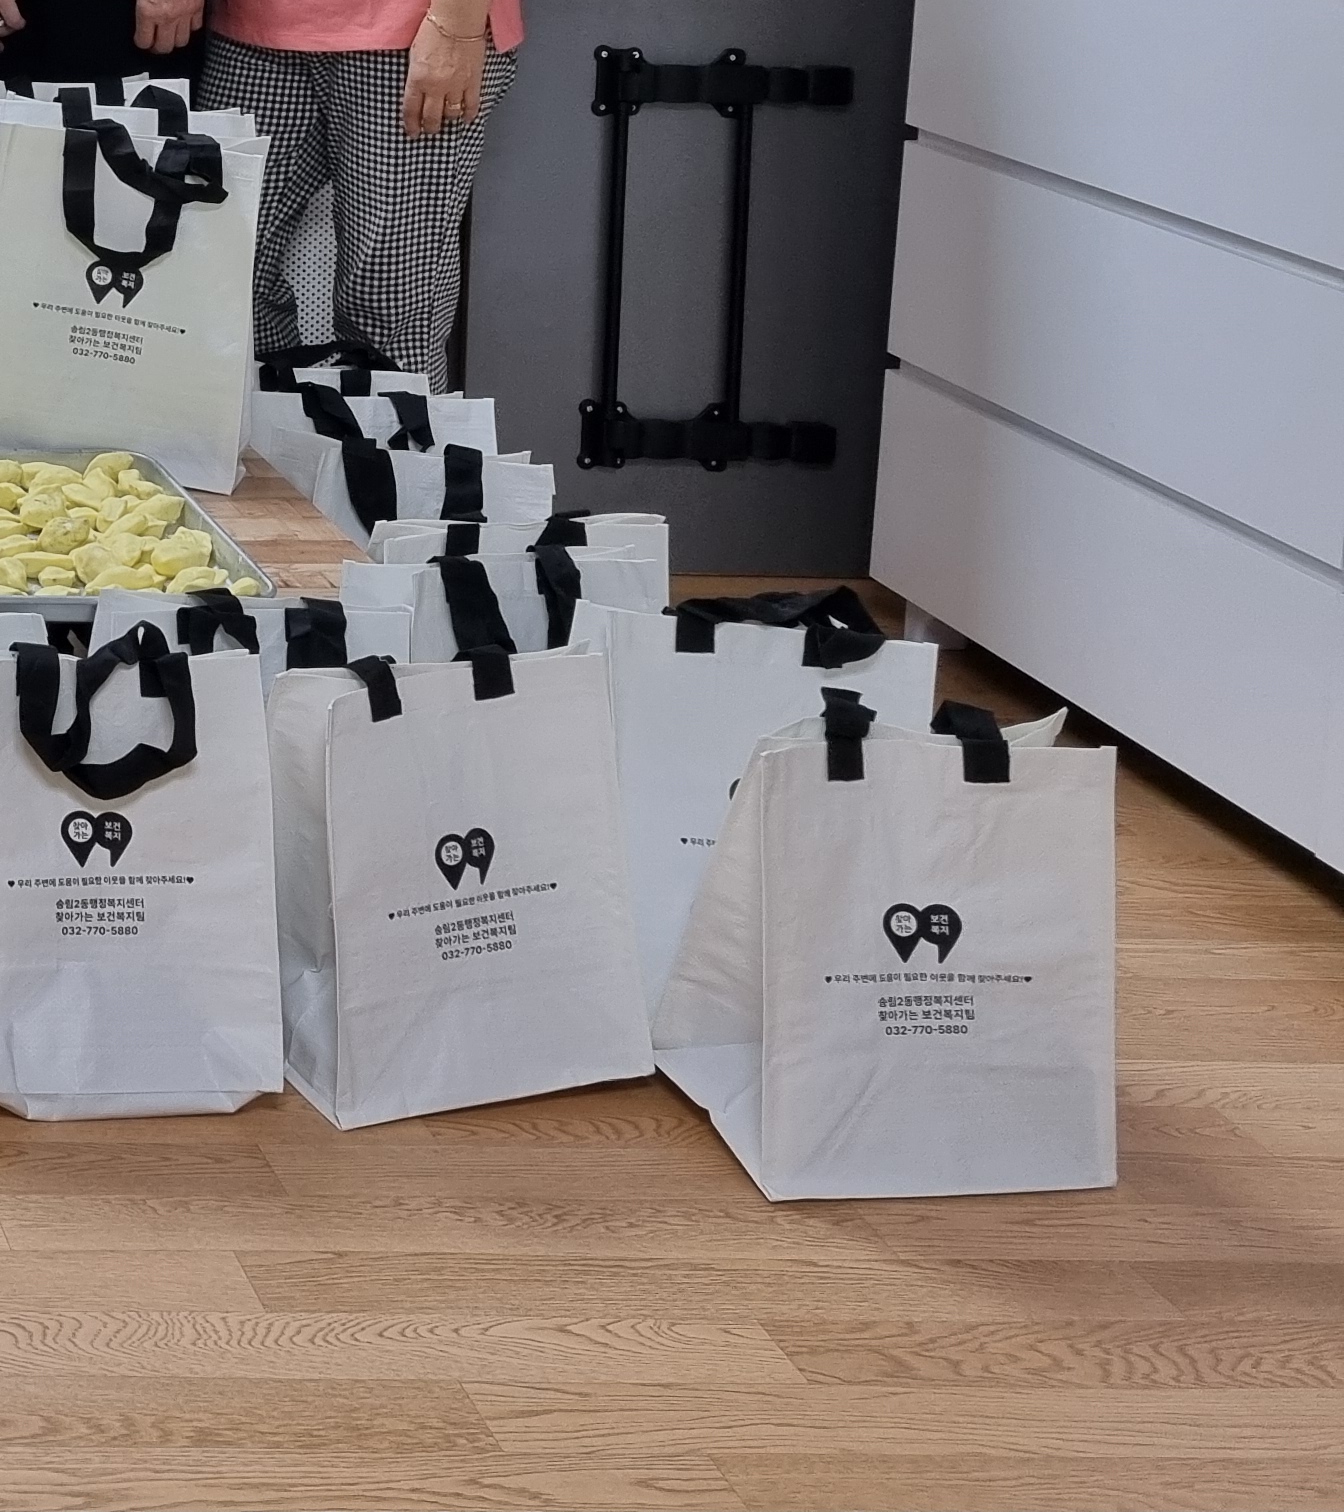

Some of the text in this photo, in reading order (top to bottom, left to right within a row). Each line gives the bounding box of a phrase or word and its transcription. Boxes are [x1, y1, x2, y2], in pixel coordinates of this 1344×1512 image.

[62, 926, 138, 936] 032-770-5880
[441, 941, 512, 960] 032-770-5880
[885, 1025, 968, 1035] 032-770-5880
